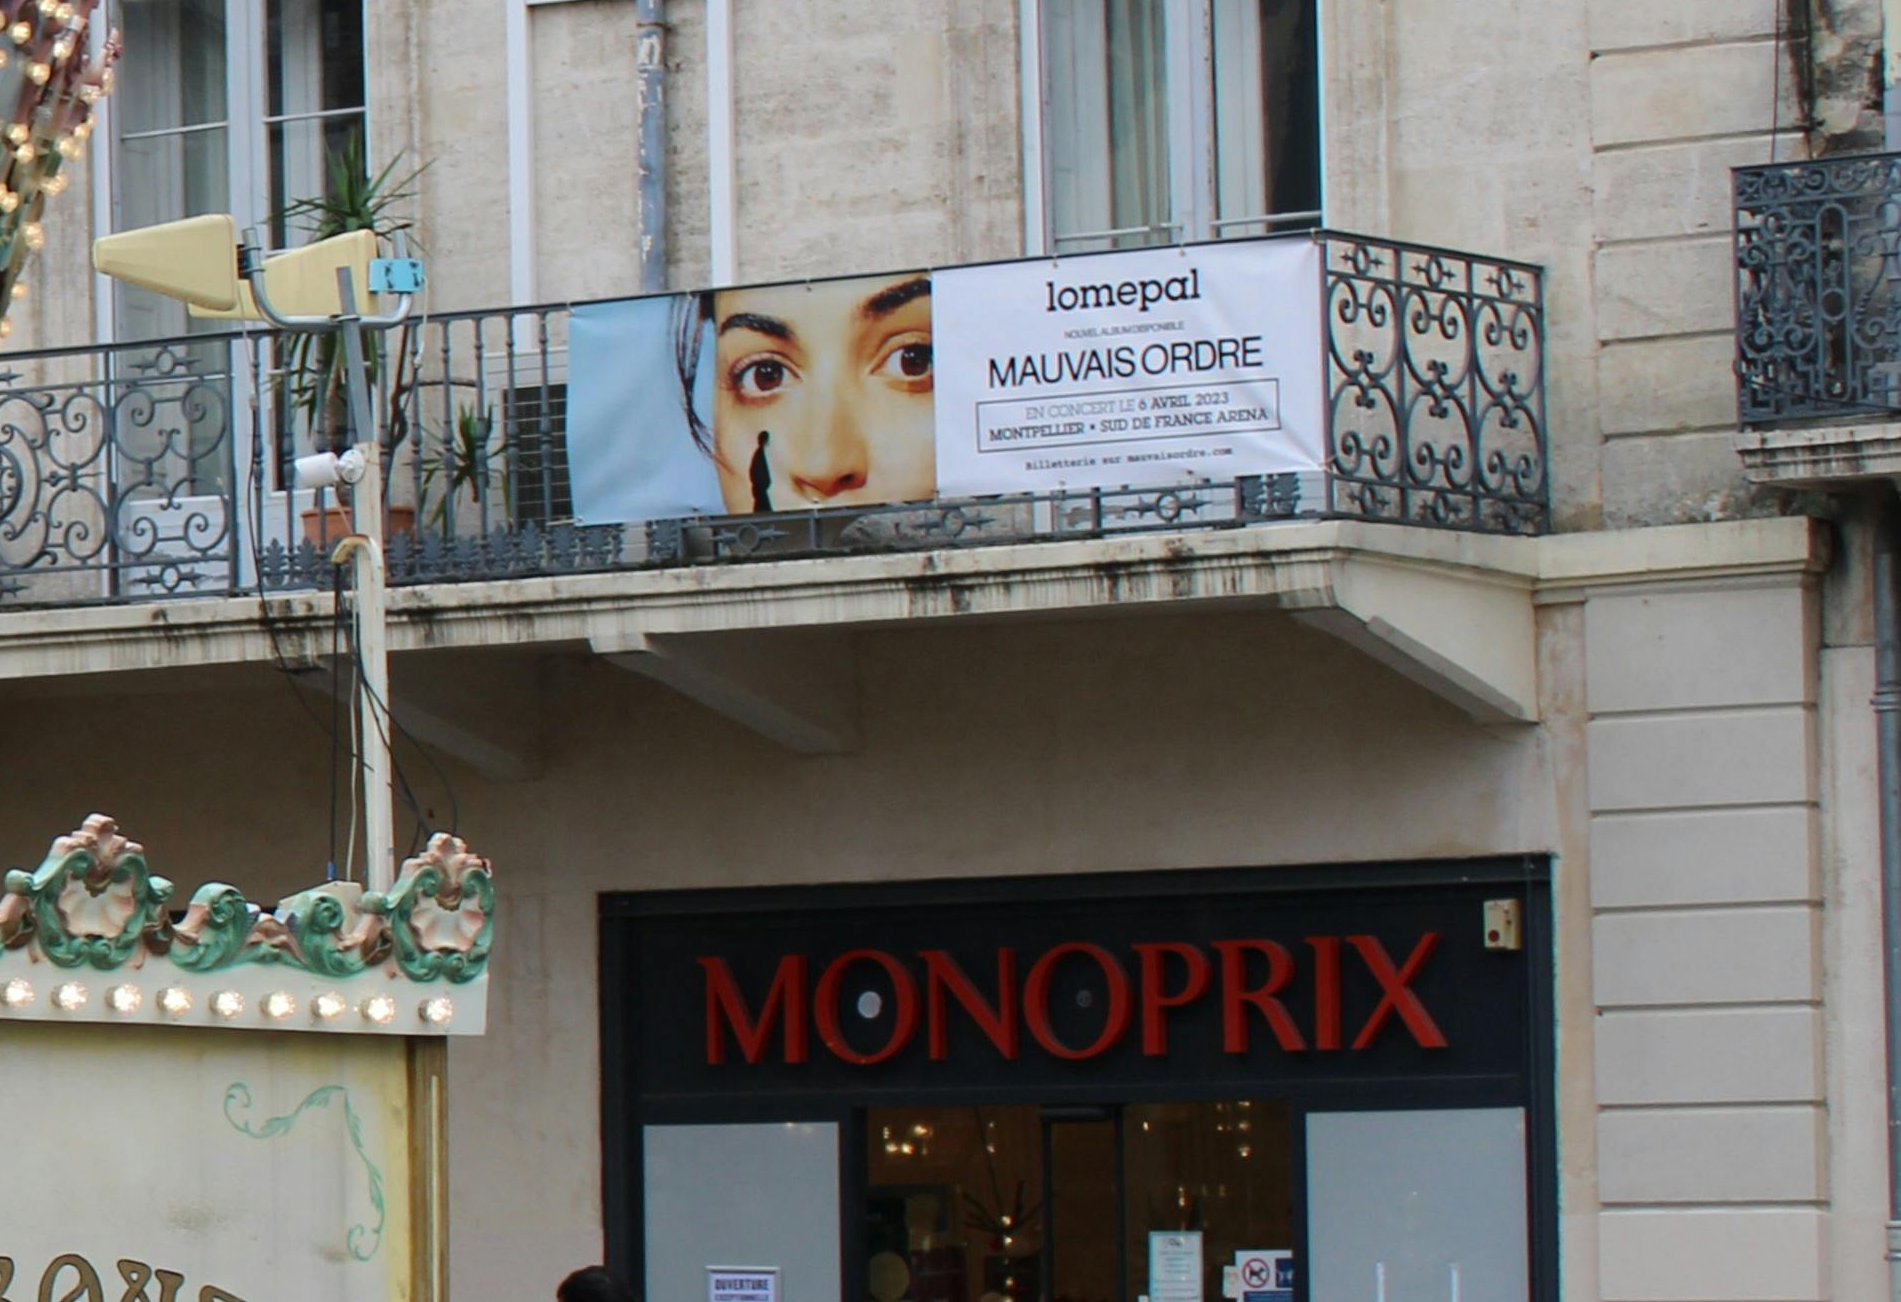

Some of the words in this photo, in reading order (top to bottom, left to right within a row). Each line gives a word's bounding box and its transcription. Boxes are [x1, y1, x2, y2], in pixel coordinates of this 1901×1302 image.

[1046, 268, 1202, 313] lomepal
[988, 347, 1136, 388] MAUVAIS
[1141, 336, 1263, 376] ORDRE
[988, 421, 1086, 442] MONTPELLIER
[1100, 418, 1129, 433] SUD
[1132, 417, 1151, 430] DE
[1154, 411, 1214, 429] FRANCE
[1216, 407, 1269, 424] ARENA
[1025, 406, 1045, 420] EN
[1047, 401, 1117, 418] CONCERT
[1119, 399, 1135, 413] LE
[1138, 399, 1147, 411] 6
[1150, 394, 1192, 410] AVRIL
[1194, 391, 1230, 406] 2023
[697, 930, 1449, 1066] MONOPRIX
